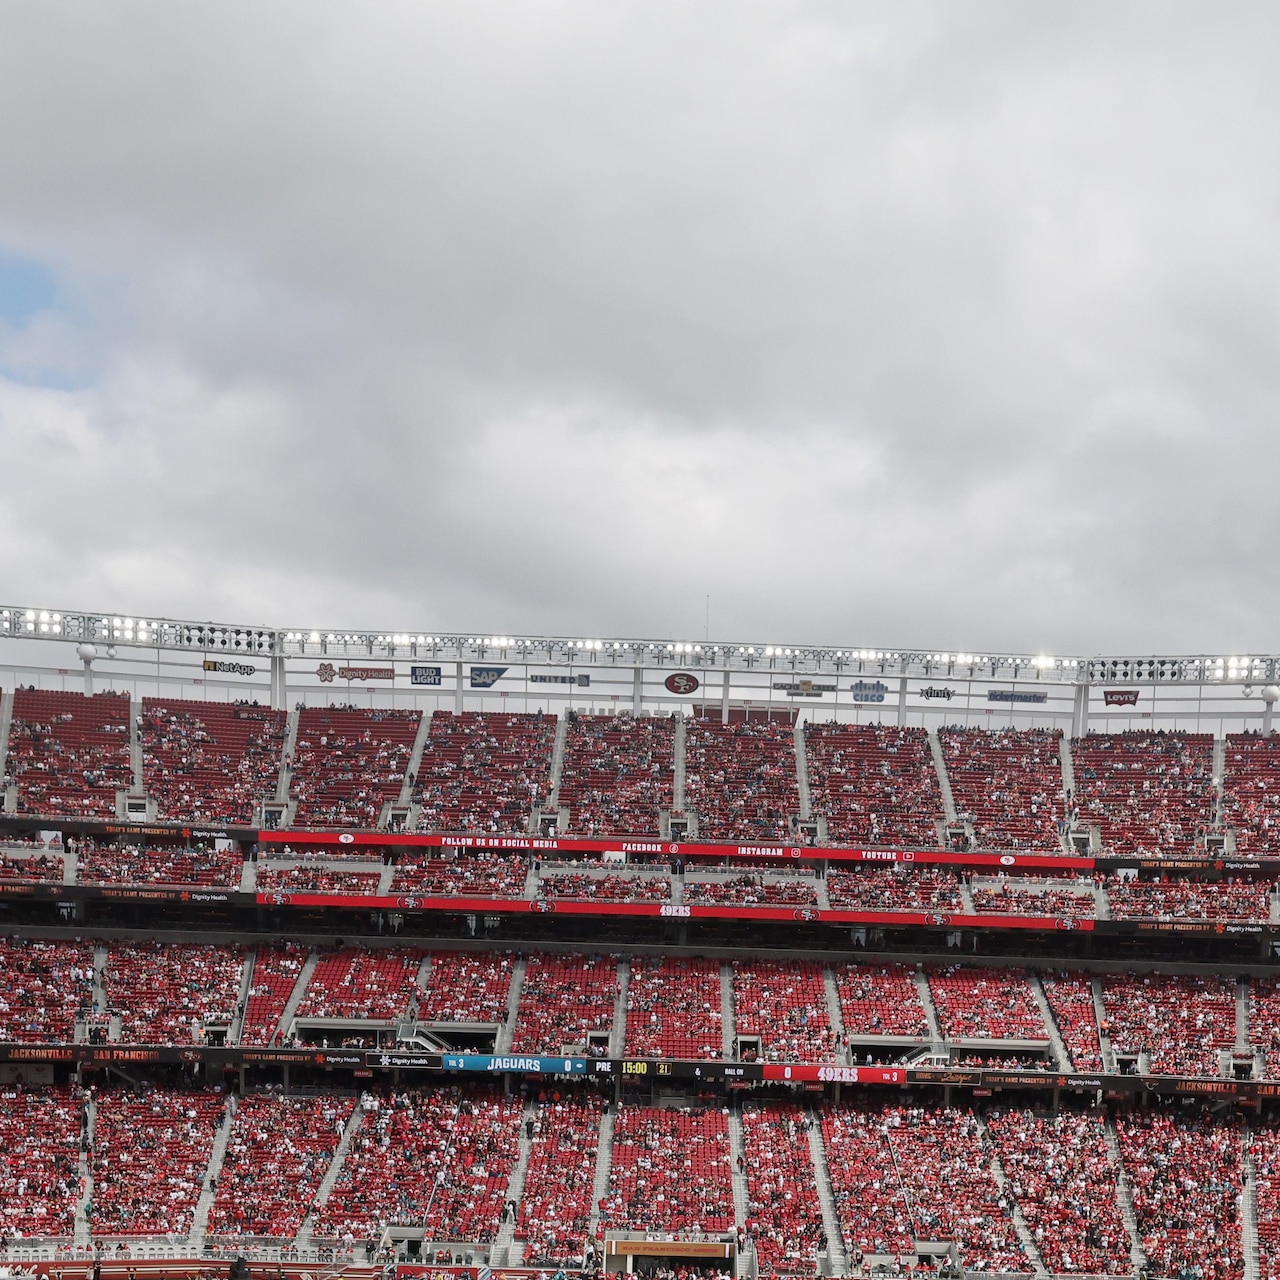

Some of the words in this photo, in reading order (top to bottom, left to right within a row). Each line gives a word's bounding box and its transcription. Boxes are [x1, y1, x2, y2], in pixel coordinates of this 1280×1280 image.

[215, 661, 255, 675] NetApp
[415, 667, 436, 676] BUD
[339, 667, 367, 680] Dignity
[368, 669, 394, 679] Health
[472, 671, 498, 684] SAP
[412, 675, 440, 684] LIGHT
[530, 675, 576, 684] UNITED
[853, 693, 884, 703] CISCO
[919, 686, 956, 700] xfinity
[989, 691, 1047, 703] ticketmaster
[193, 830, 210, 838] Dignity
[441, 837, 473, 846] FOLLOW
[476, 838, 486, 846] US
[489, 838, 499, 847] ON
[502, 839, 530, 848] SOCIAL
[533, 840, 558, 849] MEDIA
[622, 843, 662, 852] FACEBOOK
[738, 847, 783, 856] INSTAGRAM
[861, 851, 897, 860] YOUTUBE
[192, 893, 210, 901] Dignity
[660, 905, 690, 917] 49ERS
[1226, 925, 1244, 933] Dignity
[8, 1049, 73, 1059] JACKSONVILLE
[93, 1050, 110, 1060] SAN
[113, 1050, 159, 1060] FRANCISCO
[392, 1057, 410, 1065] Dignity
[458, 1058, 464, 1068] 3
[487, 1058, 540, 1072] JAGUARS
[564, 1060, 571, 1071] 0
[596, 1062, 611, 1072] PRE
[622, 1062, 647, 1074] 15:00
[659, 1065, 668, 1073] 21
[784, 1067, 791, 1078] 0
[817, 1067, 858, 1082] 49ERS
[892, 1072, 898, 1082] 3
[1257, 1085, 1274, 1095] SAN
